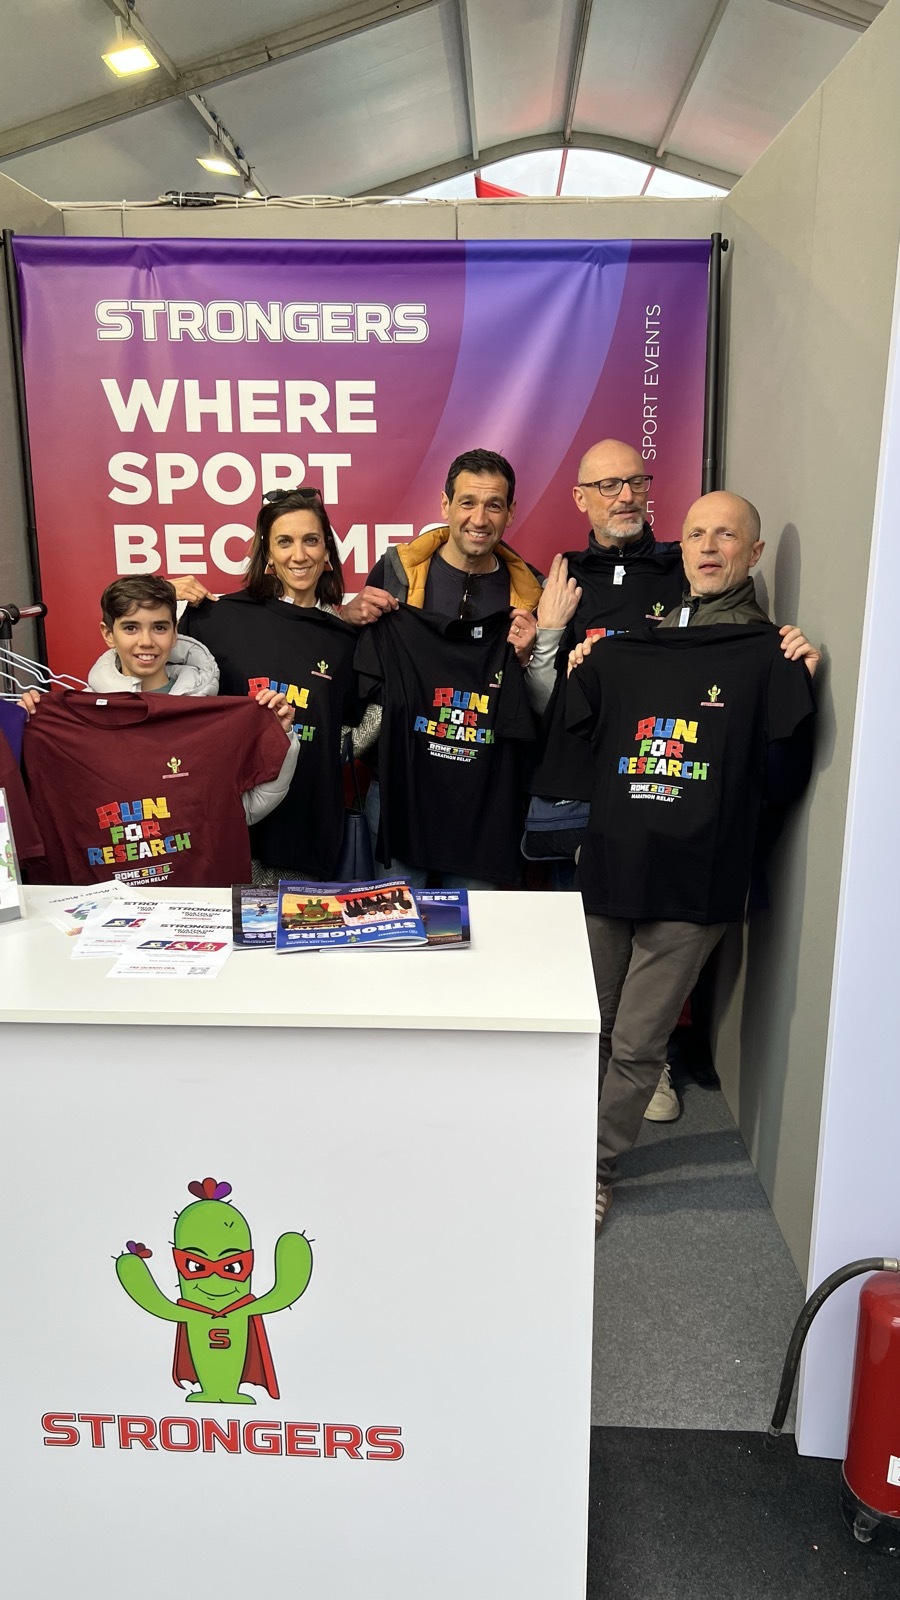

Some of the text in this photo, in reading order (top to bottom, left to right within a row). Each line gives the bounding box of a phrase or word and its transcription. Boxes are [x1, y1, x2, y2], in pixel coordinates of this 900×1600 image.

[95, 300, 430, 343] STRONGERS
[642, 304, 661, 460] SPORT EVENTS
[100, 378, 377, 433] WHERE
[107, 451, 352, 505] SPORT
[113, 523, 450, 575] BECME
[433, 688, 490, 714] RUN
[439, 707, 478, 726] FOR
[414, 716, 495, 744] RESEARCH
[635, 716, 699, 743] RUN
[429, 743, 451, 752] ROME
[430, 751, 456, 760] MARATHON
[639, 739, 684, 758] FOR
[618, 756, 709, 780] RESEARCH
[630, 784, 679, 795] ROME 2026
[96, 797, 171, 829] RUN
[110, 820, 162, 844] FOR
[87, 832, 191, 865] RESEARCH
[114, 865, 170, 881] ROME 2026
[126, 875, 169, 887] RATHON RELAY
[287, 921, 416, 940] STRONGERS
[209, 1328, 231, 1349] S
[41, 1412, 405, 1461] STRONGERS
